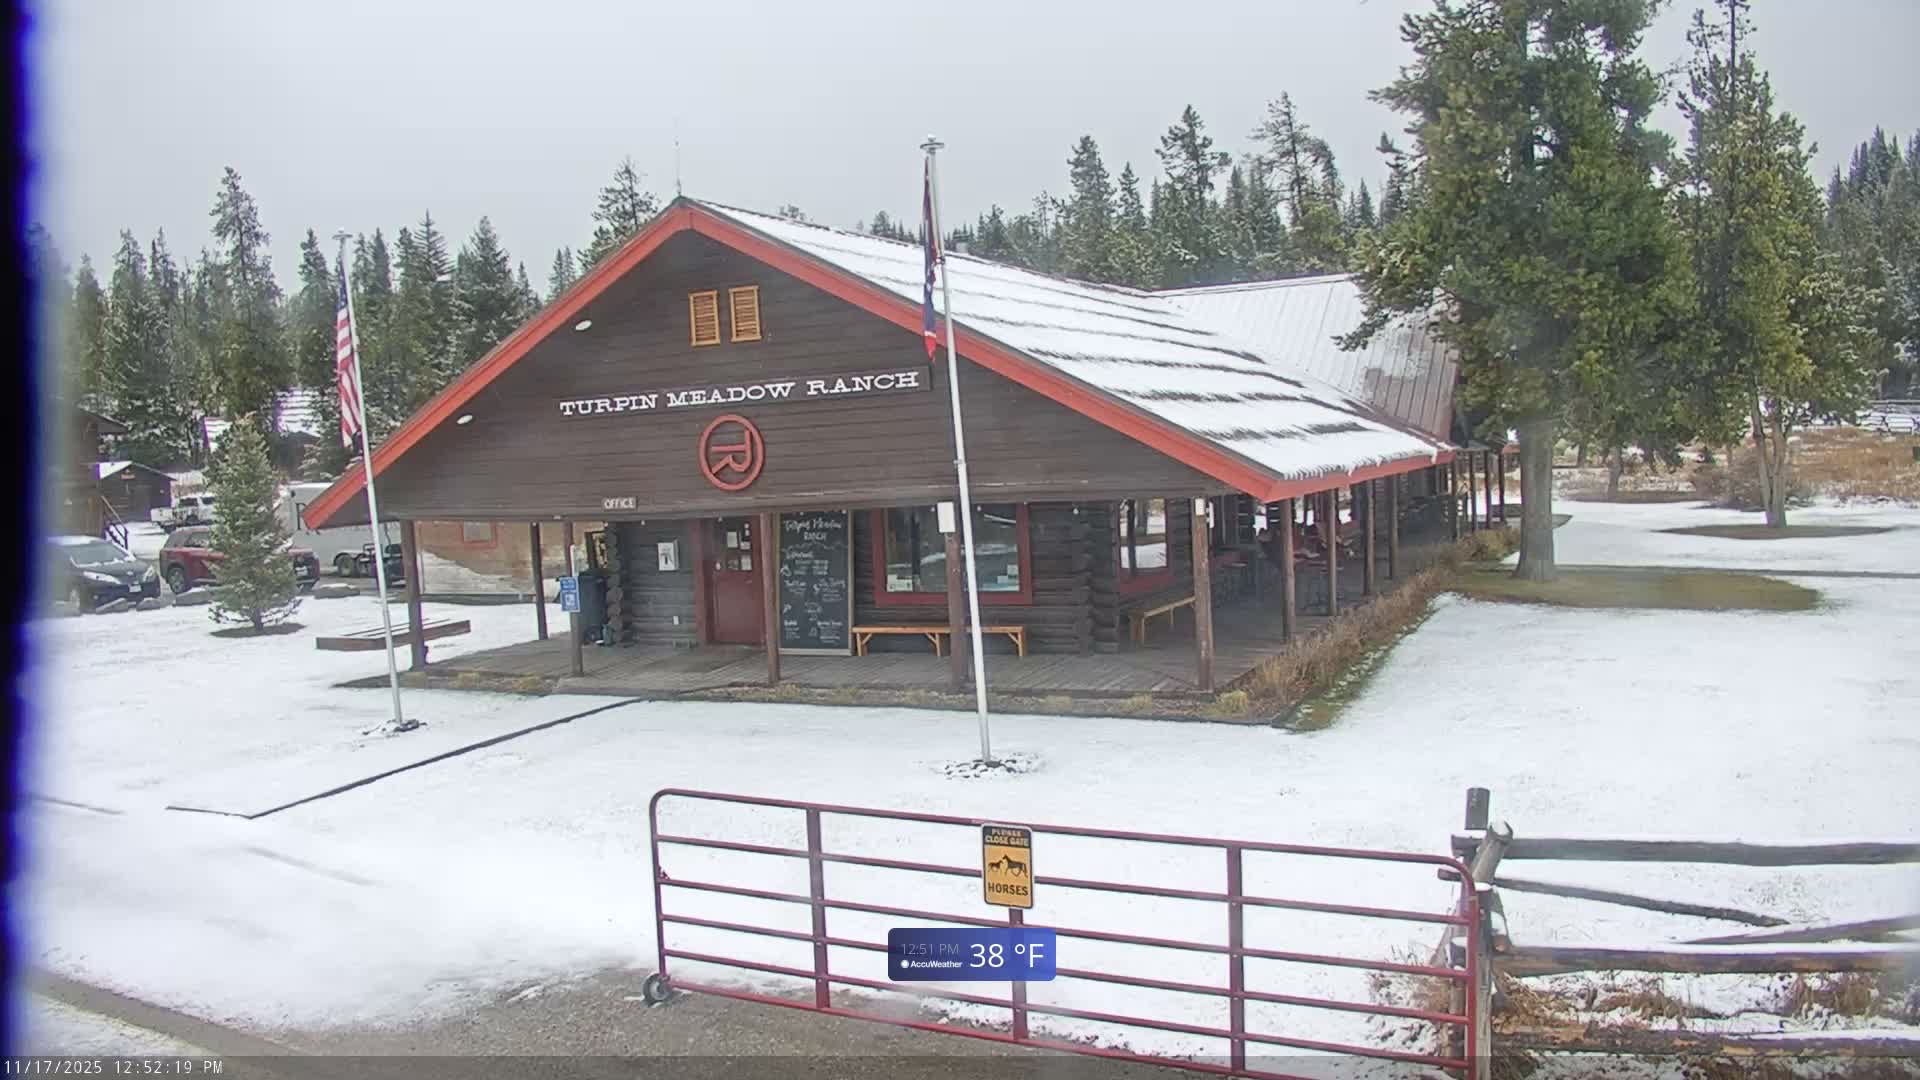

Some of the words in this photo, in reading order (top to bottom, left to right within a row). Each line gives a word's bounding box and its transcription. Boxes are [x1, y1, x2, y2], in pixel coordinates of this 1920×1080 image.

[559, 393, 659, 416] TURPIN
[666, 381, 796, 407] MEADOW
[806, 371, 920, 396] RANCH
[604, 497, 635, 509] OFFICE
[984, 835, 1009, 845] CLOSE
[1009, 836, 1030, 847] GATE
[987, 882, 1029, 896] HORSES
